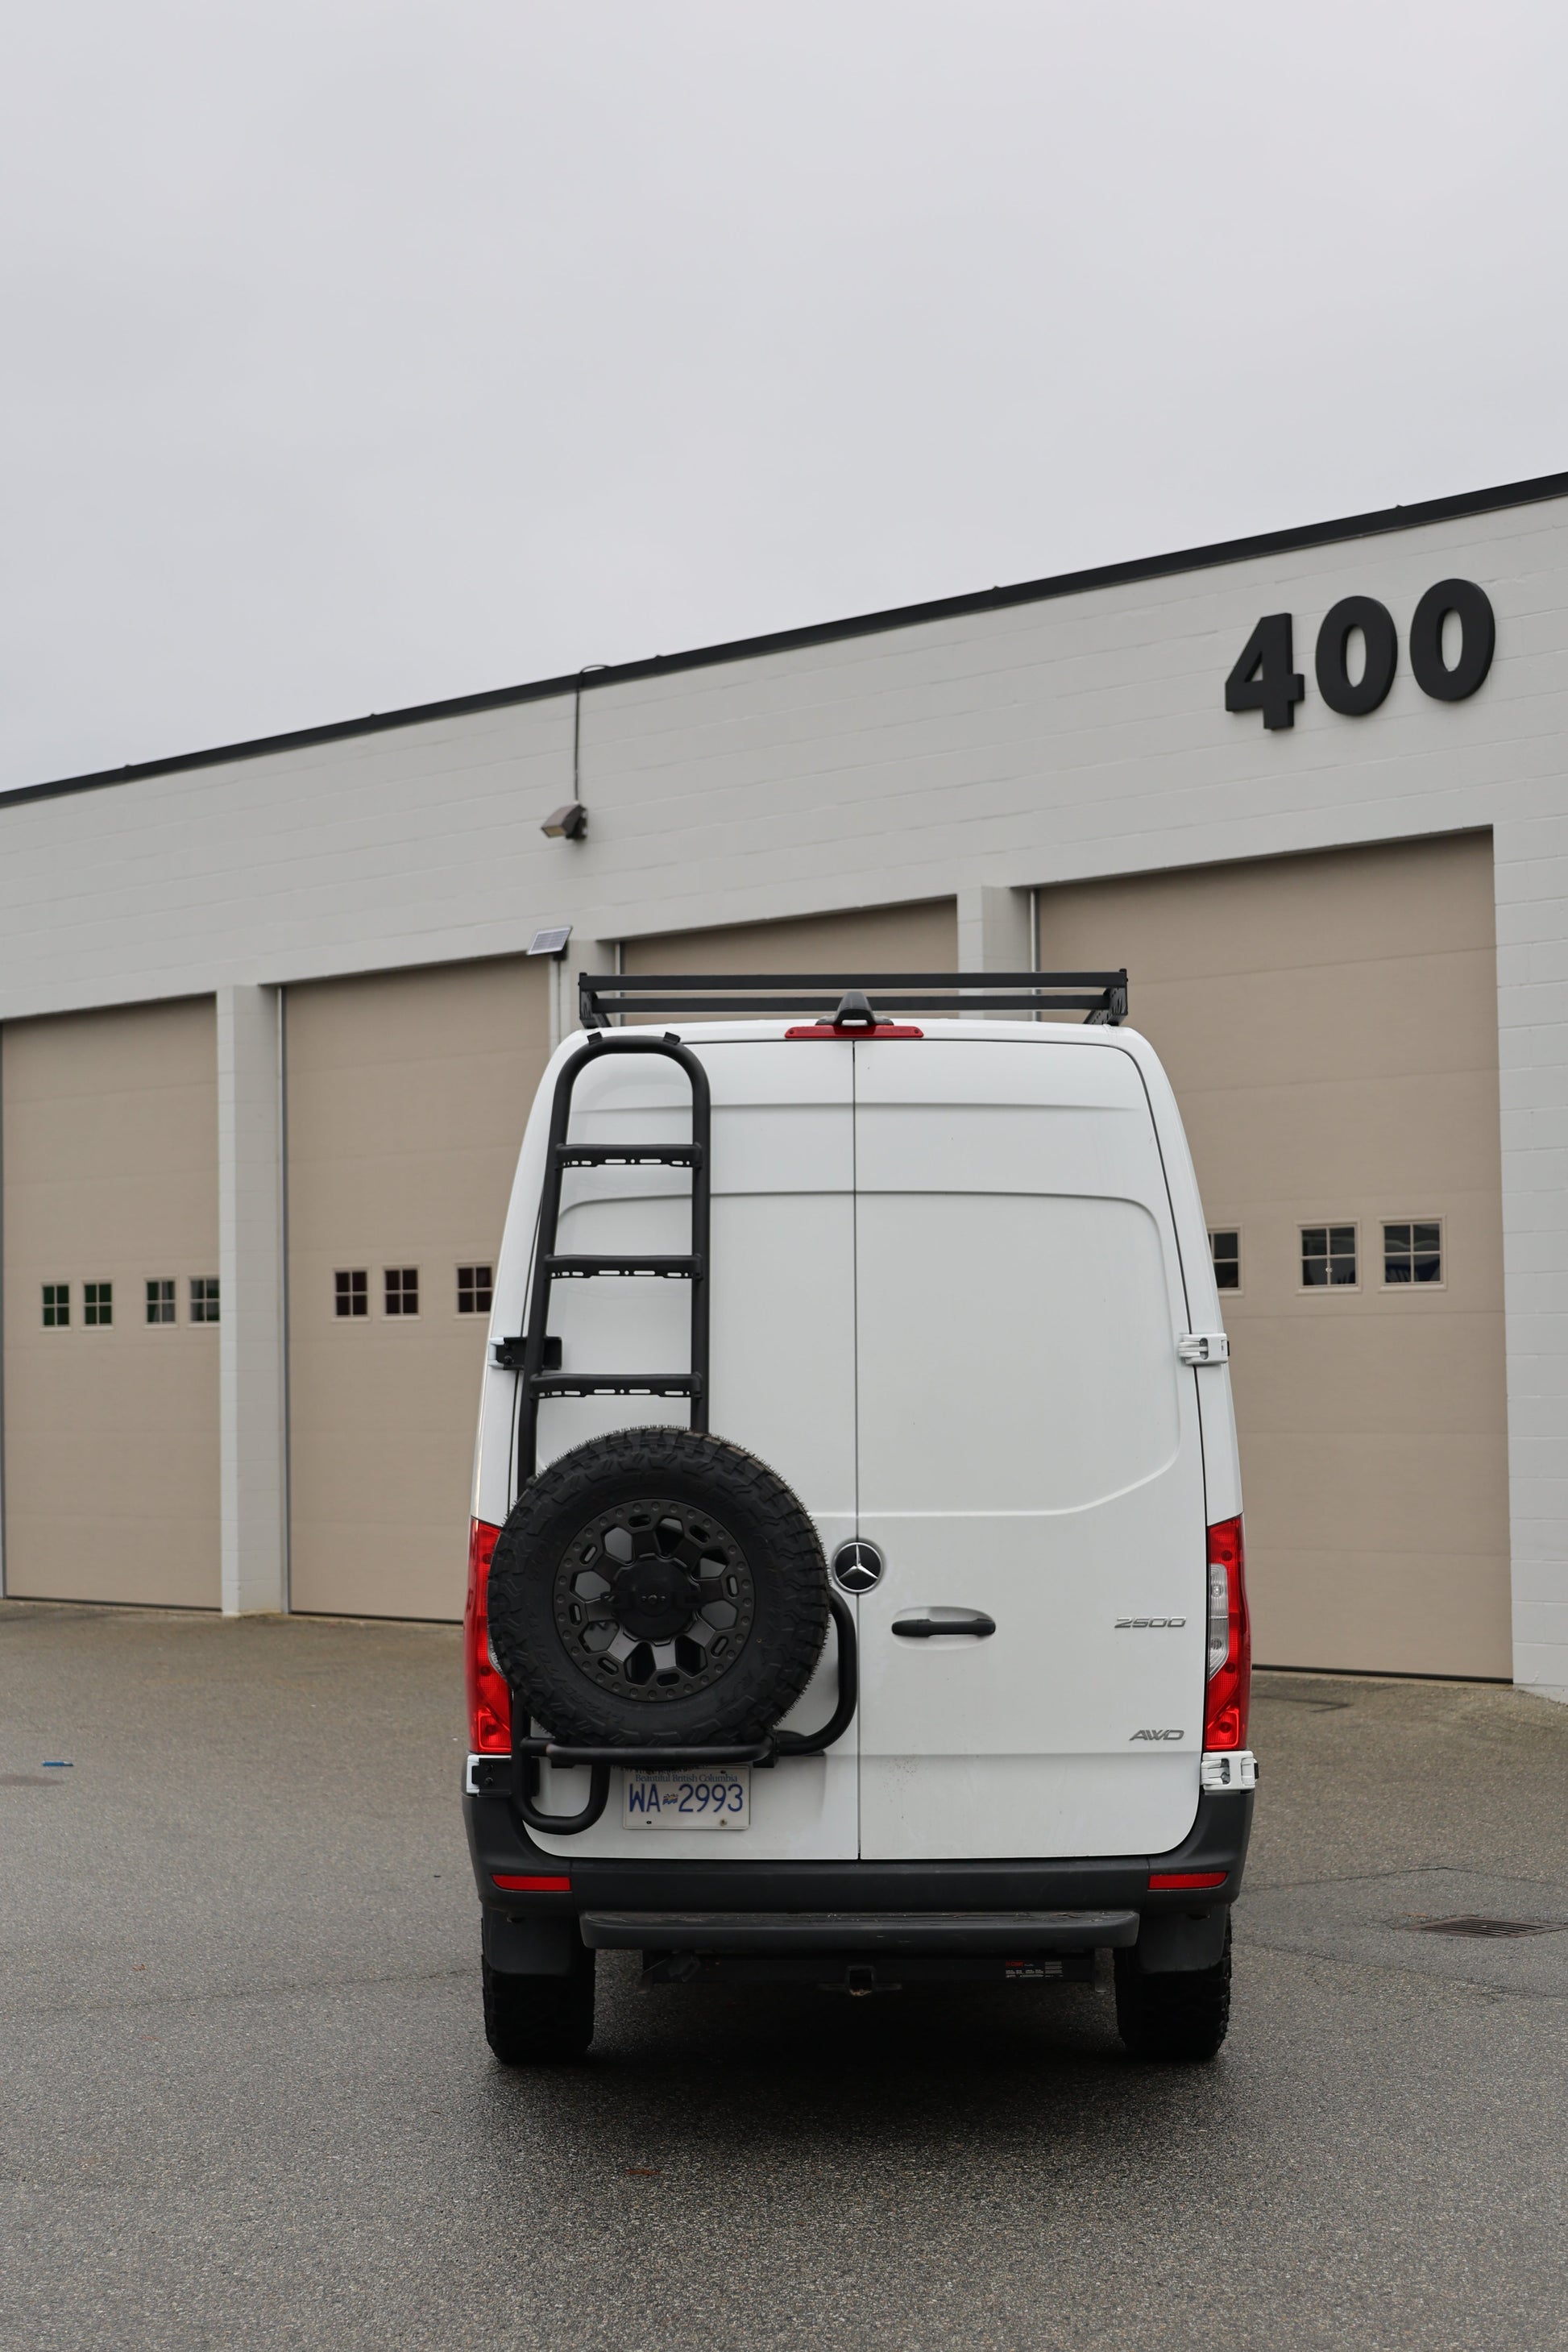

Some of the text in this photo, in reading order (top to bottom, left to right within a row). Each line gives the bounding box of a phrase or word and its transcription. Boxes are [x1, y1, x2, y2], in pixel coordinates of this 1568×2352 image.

[1224, 578, 1496, 731] 400
[1114, 1616, 1187, 1628] 2500
[1129, 1729, 1185, 1741] AWD
[636, 1774, 738, 1782] Beautiful British Columbia
[629, 1783, 744, 1812] WA 2993
